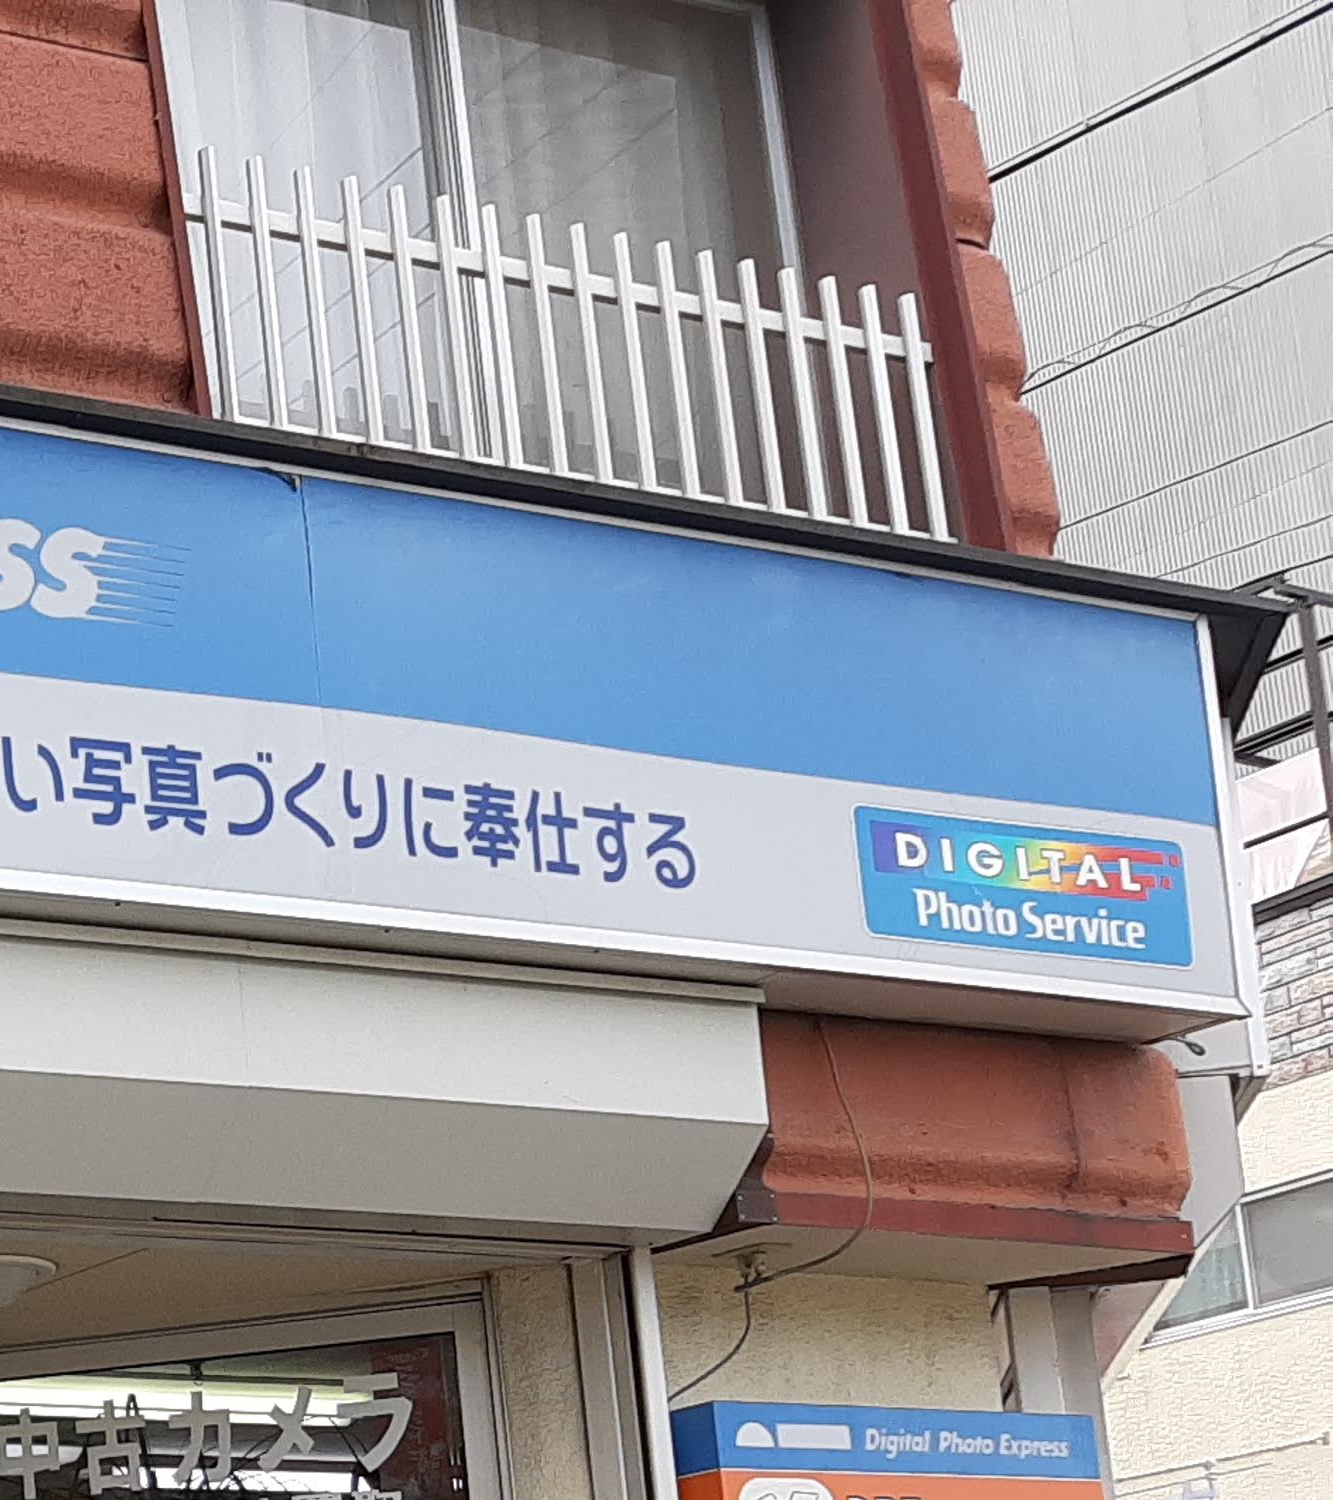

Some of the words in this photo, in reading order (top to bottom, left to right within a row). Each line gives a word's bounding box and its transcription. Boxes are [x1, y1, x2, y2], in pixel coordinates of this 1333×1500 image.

[894, 832, 1141, 892] DIGITAL
[913, 886, 1019, 937] Photo
[1022, 902, 1147, 949] Service
[864, 1427, 931, 1460] Digital
[938, 1430, 994, 1456] Photo
[999, 1434, 1071, 1459] Express
